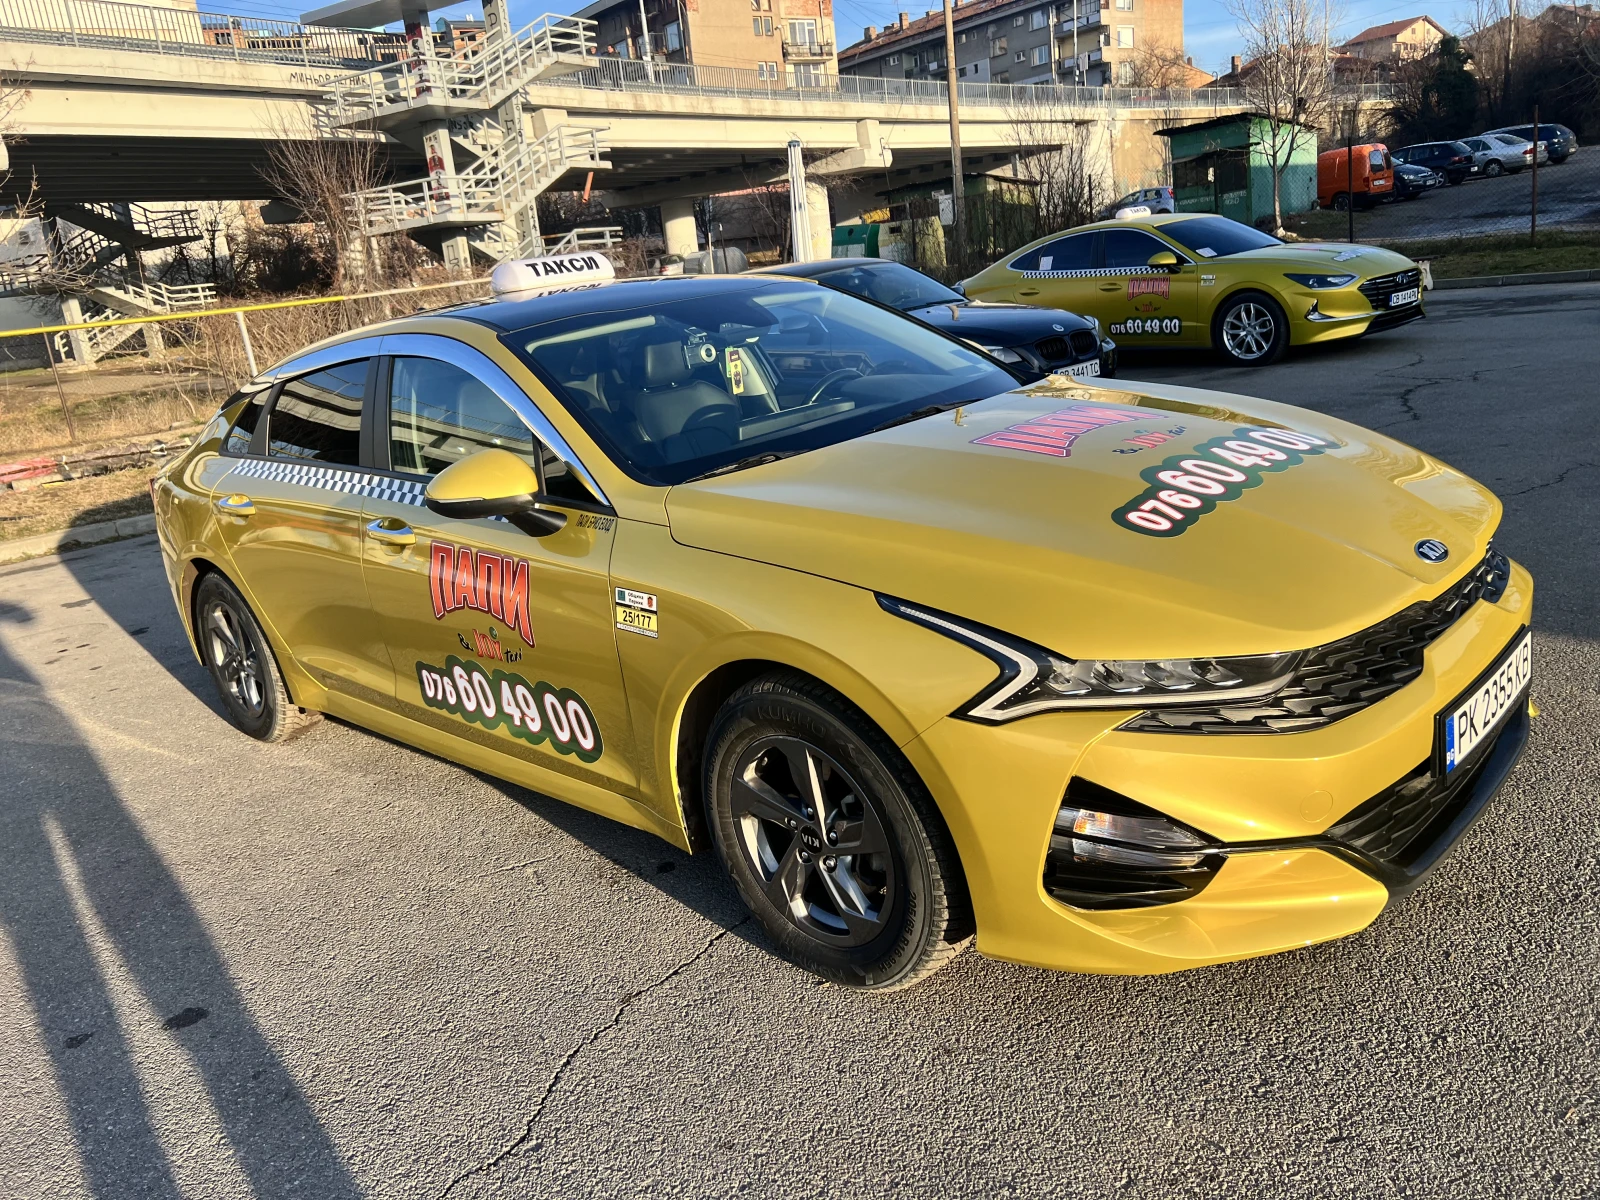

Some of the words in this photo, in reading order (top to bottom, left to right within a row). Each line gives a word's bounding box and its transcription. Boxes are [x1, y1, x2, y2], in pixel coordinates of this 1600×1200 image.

[525, 256, 600, 277] ТАКСИ
[1127, 276, 1170, 301] ПАПИ
[1111, 324, 1126, 334] 076
[1126, 319, 1142, 334] 60
[1144, 319, 1160, 334] 49
[1162, 318, 1179, 333] 00
[968, 405, 1168, 457] ПАПИ
[1248, 427, 1327, 451] 00
[1210, 439, 1290, 469] 49
[1156, 458, 1248, 497] 60
[1125, 489, 1203, 531] 076
[430, 540, 535, 648] ПАПИ
[622, 609, 652, 629] 25/177
[421, 668, 457, 706] 076
[452, 664, 498, 719] 60
[500, 680, 543, 735] 49
[542, 691, 596, 752] 00
[1482, 660, 1514, 731] 2355
[802, 832, 820, 848] KIA
[904, 889, 917, 937] 205/65
